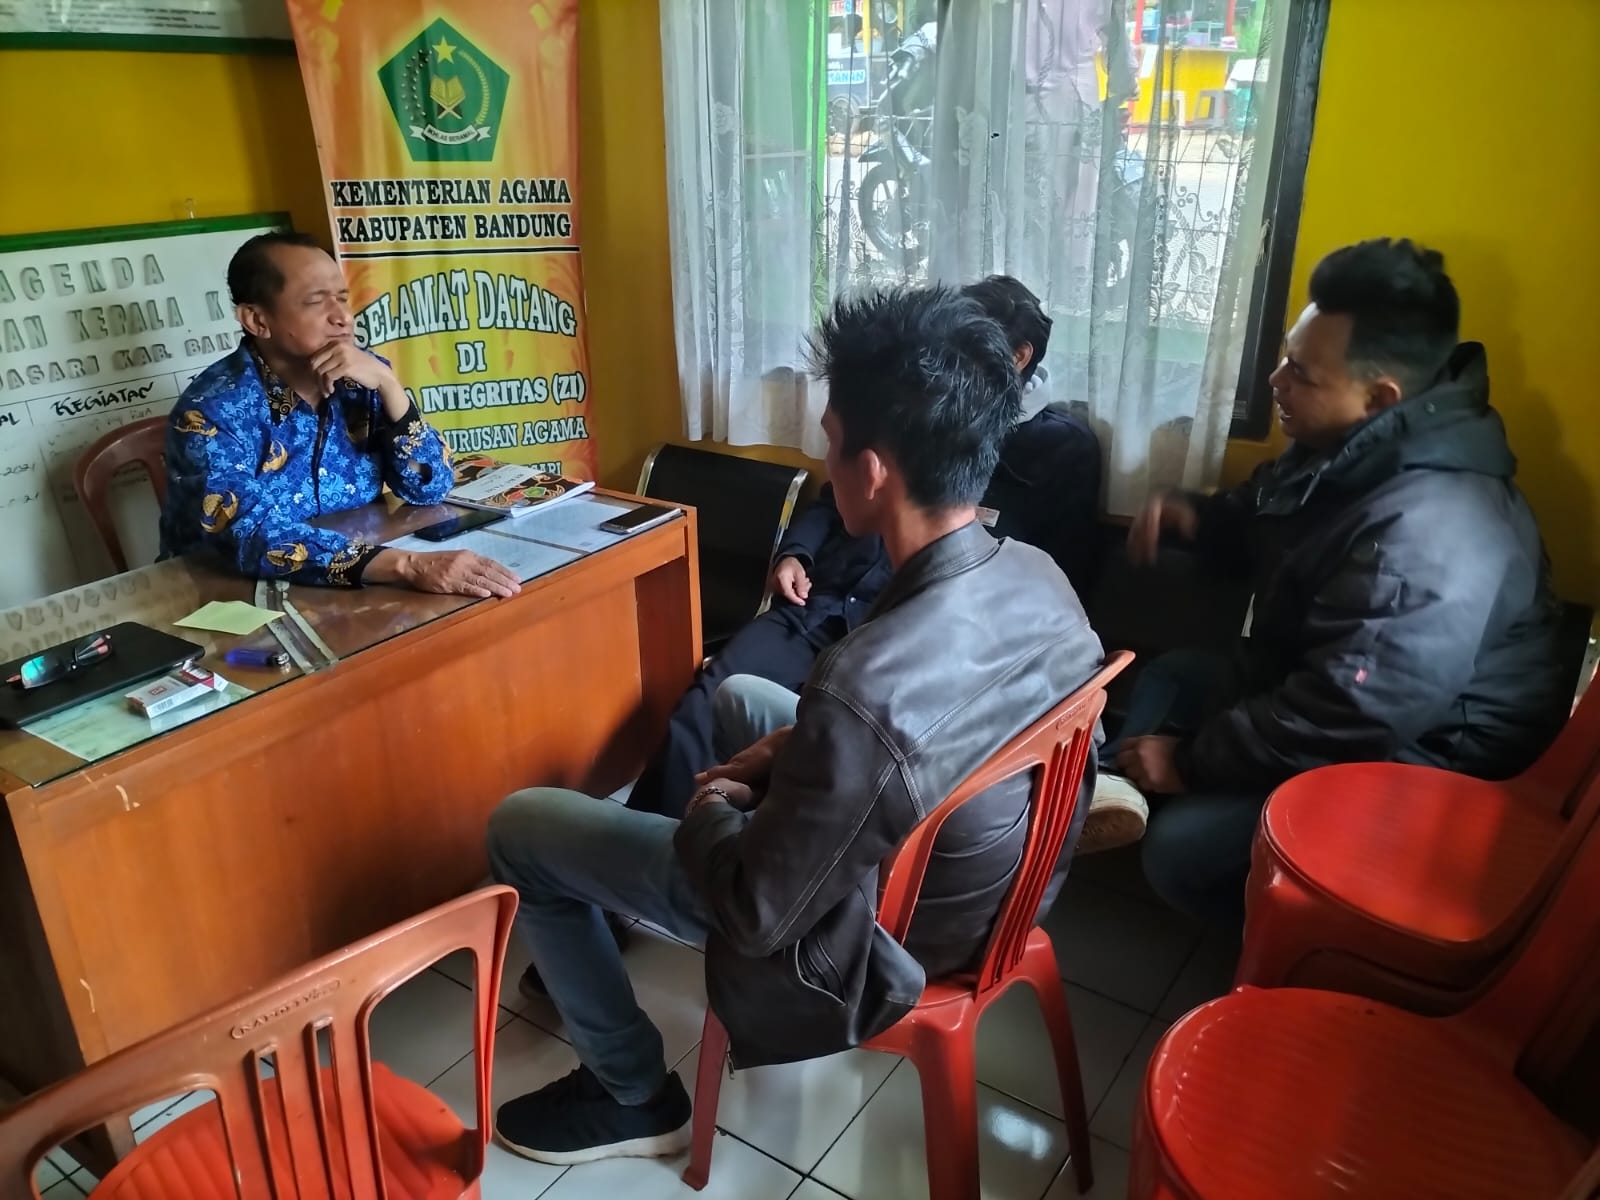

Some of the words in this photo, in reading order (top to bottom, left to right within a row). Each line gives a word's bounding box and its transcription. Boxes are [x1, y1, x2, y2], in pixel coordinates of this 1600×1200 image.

[331, 179, 491, 207] KEMENTERIAN
[498, 178, 571, 205] AGAMA
[337, 215, 466, 242] KABUPATEN
[474, 213, 571, 238] BANDUNG
[0, 254, 164, 303] AGENDA
[0, 315, 48, 353] AN
[66, 297, 184, 343] KEPALA
[353, 269, 470, 349] SELAMAT
[474, 270, 576, 336] DATANG
[456, 341, 487, 373] DI
[420, 377, 548, 413] INTEGRITAS
[551, 372, 586, 404] (ZI)
[443, 424, 519, 454] URUSAN
[521, 416, 588, 446] AGAMA
